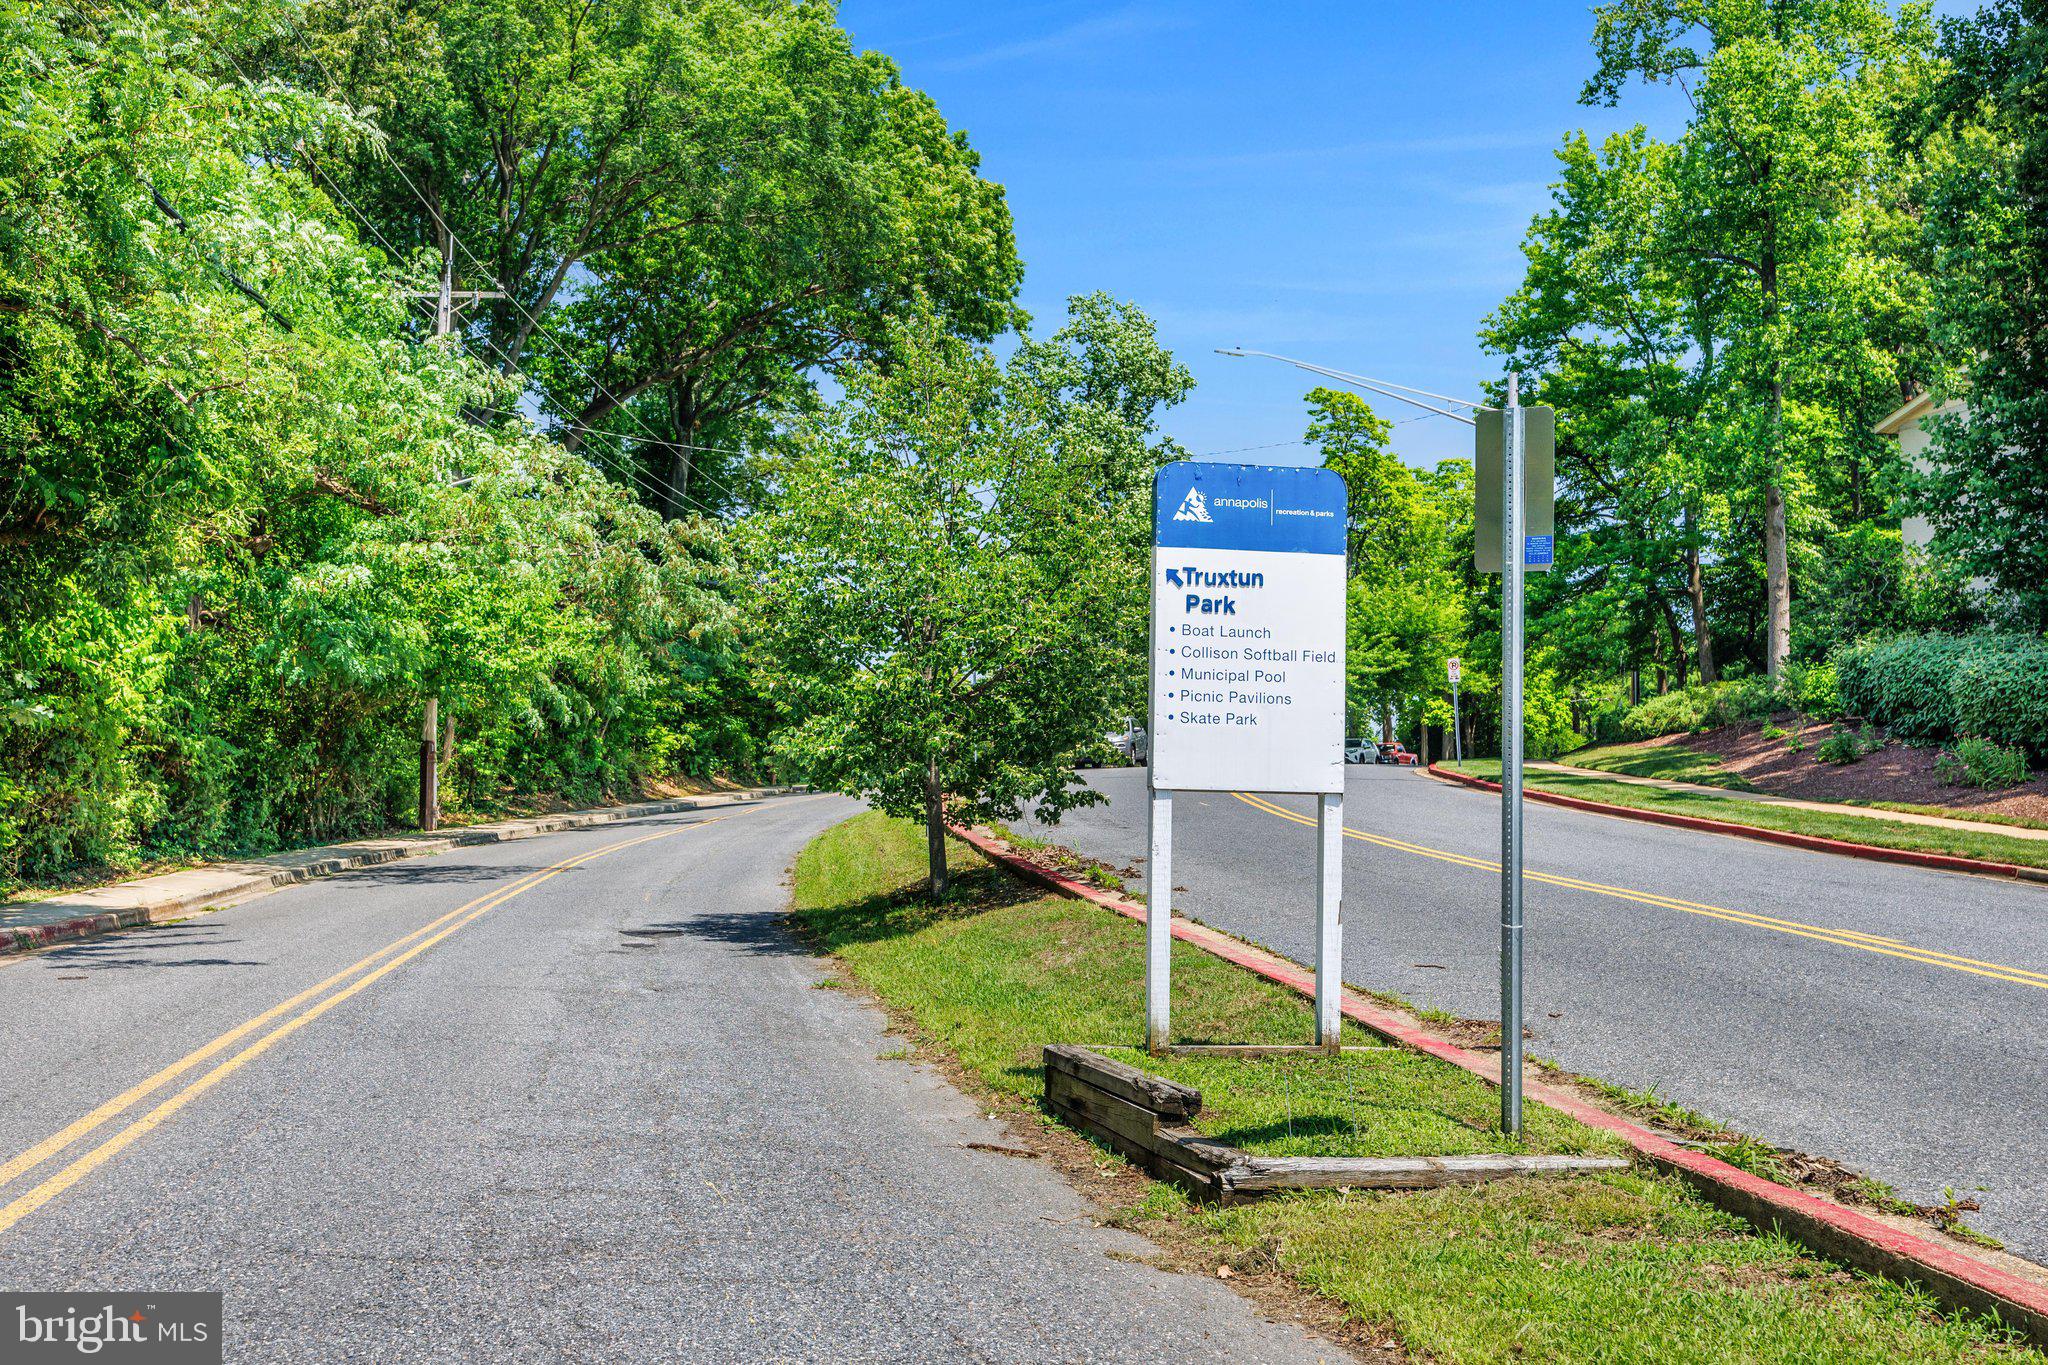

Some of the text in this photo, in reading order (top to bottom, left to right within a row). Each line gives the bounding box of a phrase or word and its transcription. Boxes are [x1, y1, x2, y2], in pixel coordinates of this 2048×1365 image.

[1213, 497, 1268, 509] annapolis
[1275, 508, 1310, 516] recreation
[1315, 510, 1334, 518] parks
[1182, 566, 1264, 588] Truxtun
[1185, 594, 1236, 615] Park
[1181, 624, 1271, 638] Boat Launch
[1181, 646, 1336, 663] Collison Softball Field
[1181, 668, 1286, 683] Municipal Pool
[1180, 690, 1292, 704] Picnic Pavilions
[1180, 712, 1258, 725] Skate Park
